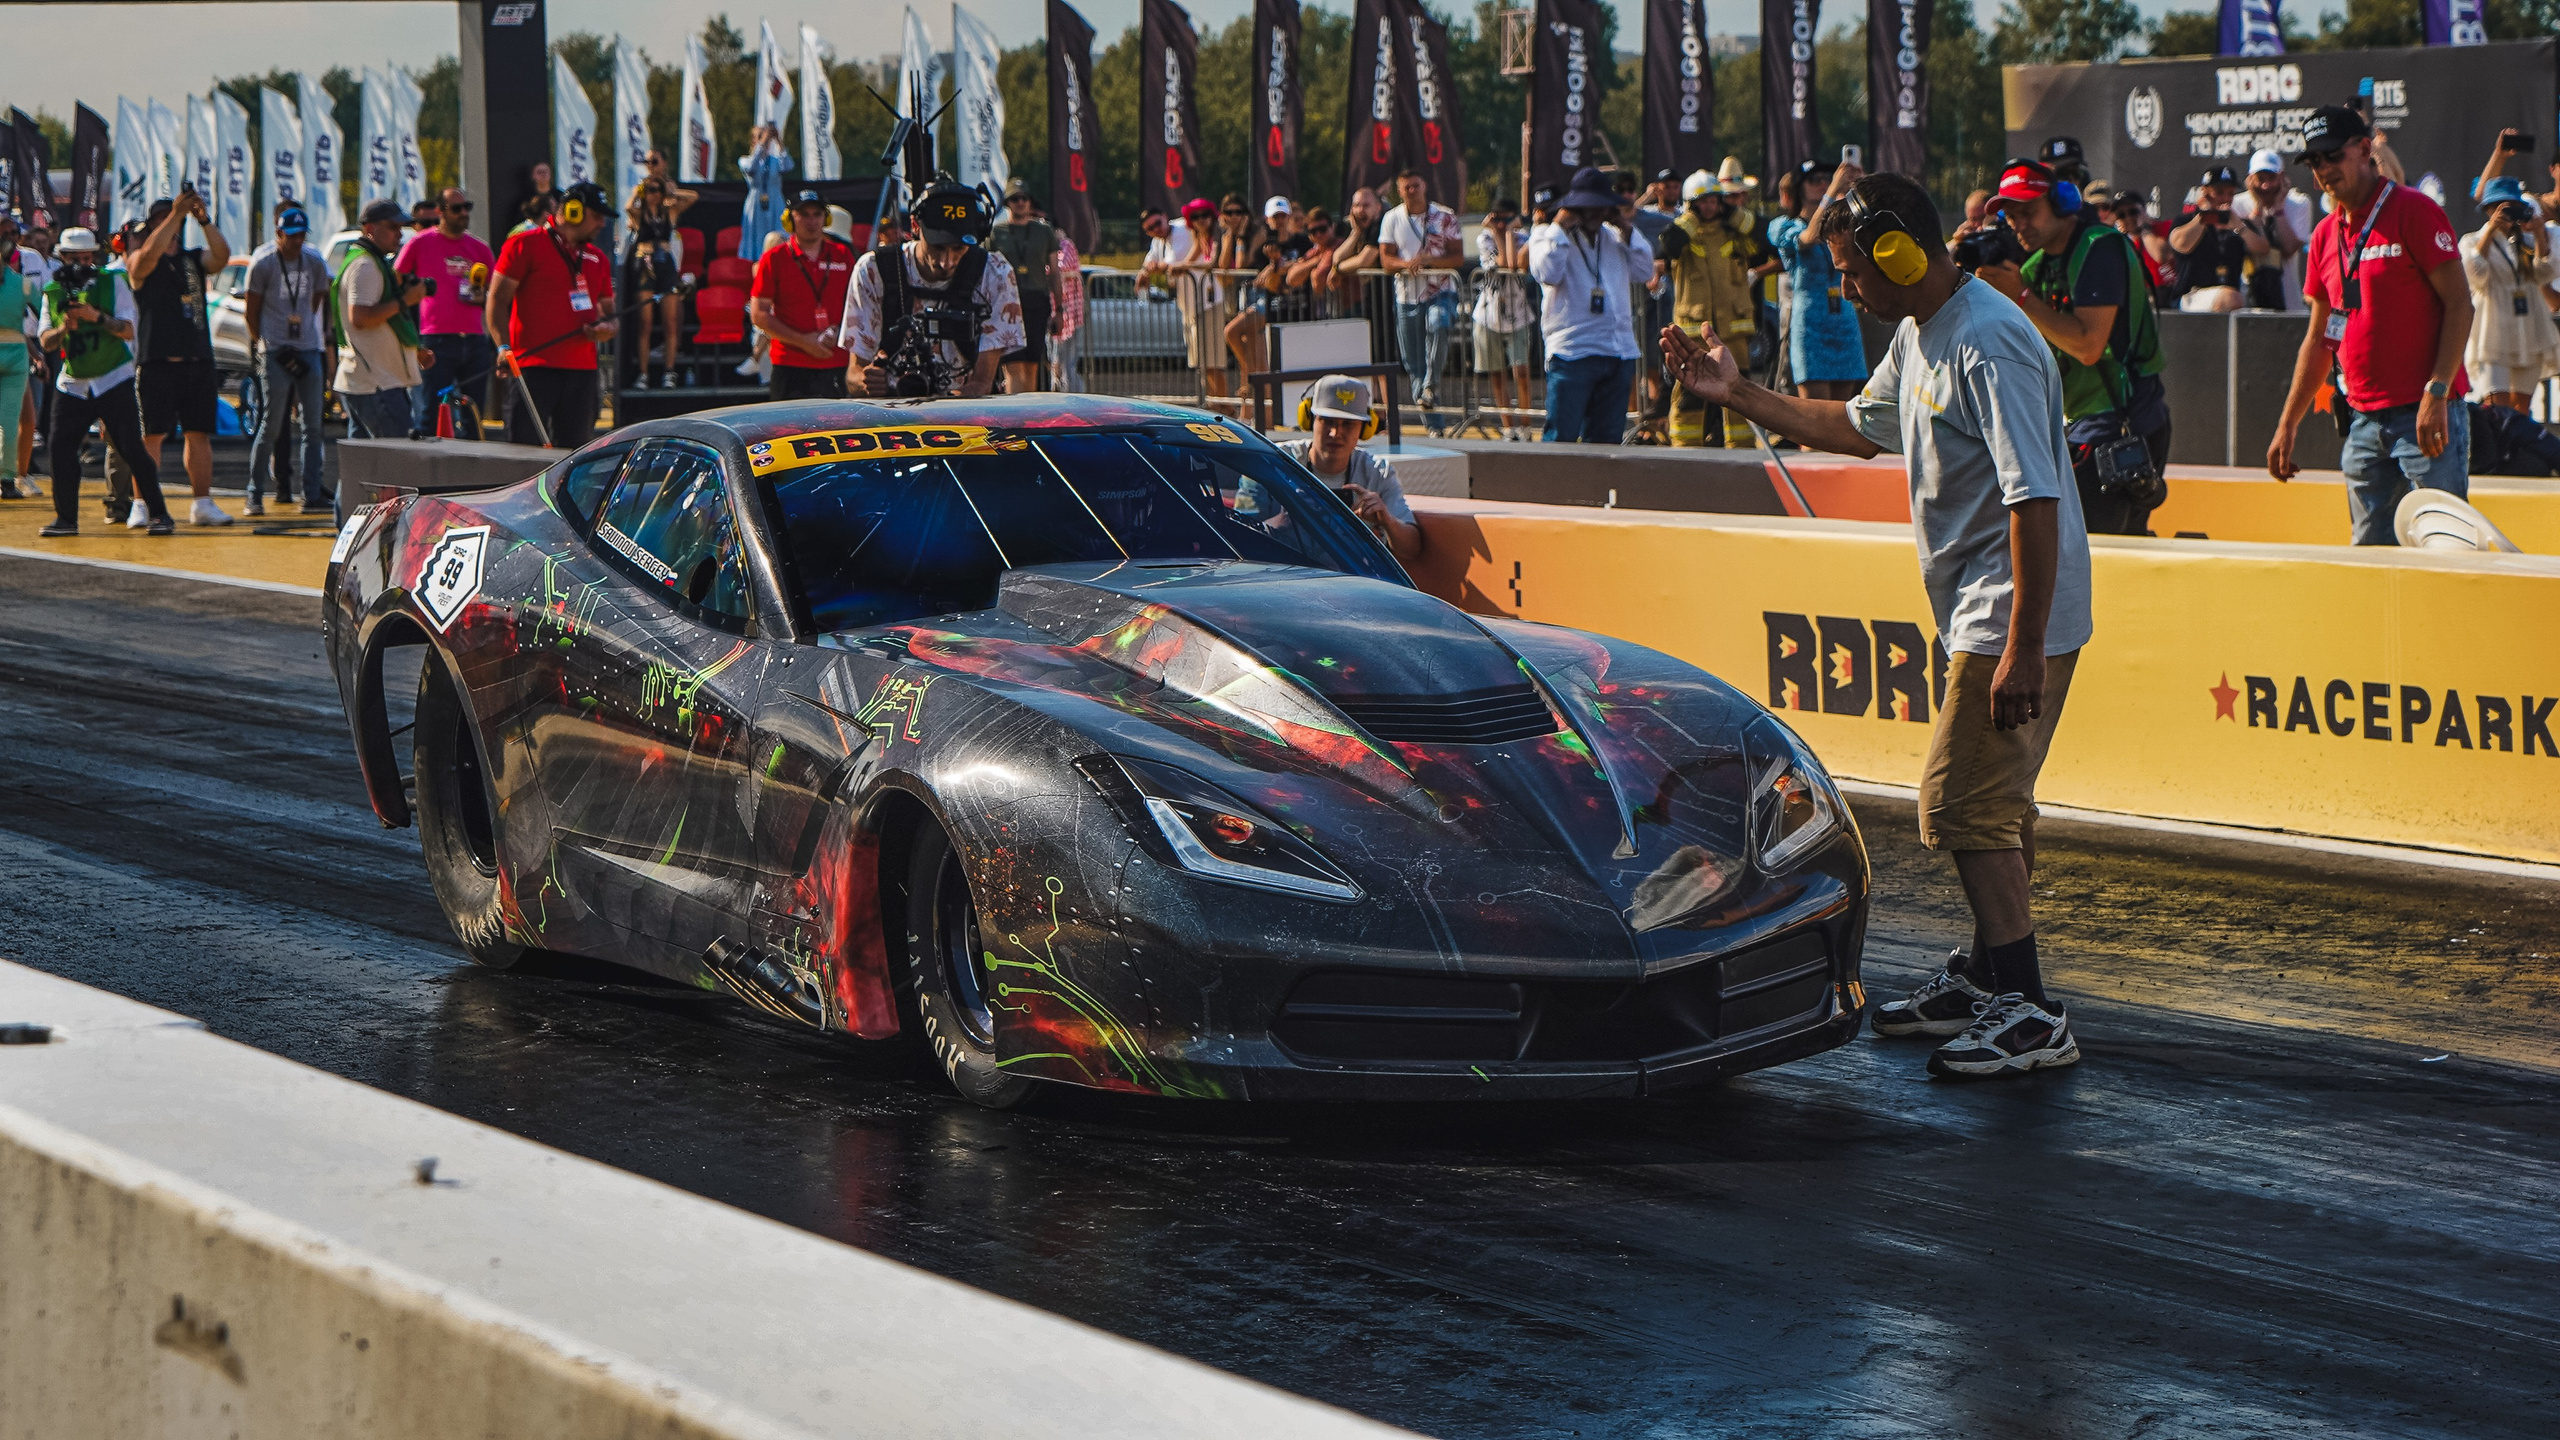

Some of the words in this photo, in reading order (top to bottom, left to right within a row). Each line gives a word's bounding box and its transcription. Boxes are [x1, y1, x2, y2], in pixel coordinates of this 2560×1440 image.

[2217, 63, 2303, 105] RDRC
[2373, 80, 2407, 107] ВТБ
[942, 205, 966, 220] 7,6
[787, 431, 961, 458] RDRC
[1184, 423, 1243, 444] 99
[1097, 488, 1147, 499] SIMPSON
[439, 558, 464, 590] 99
[633, 549, 670, 580] SERGEY
[2244, 675, 2560, 758] RACEPARK
